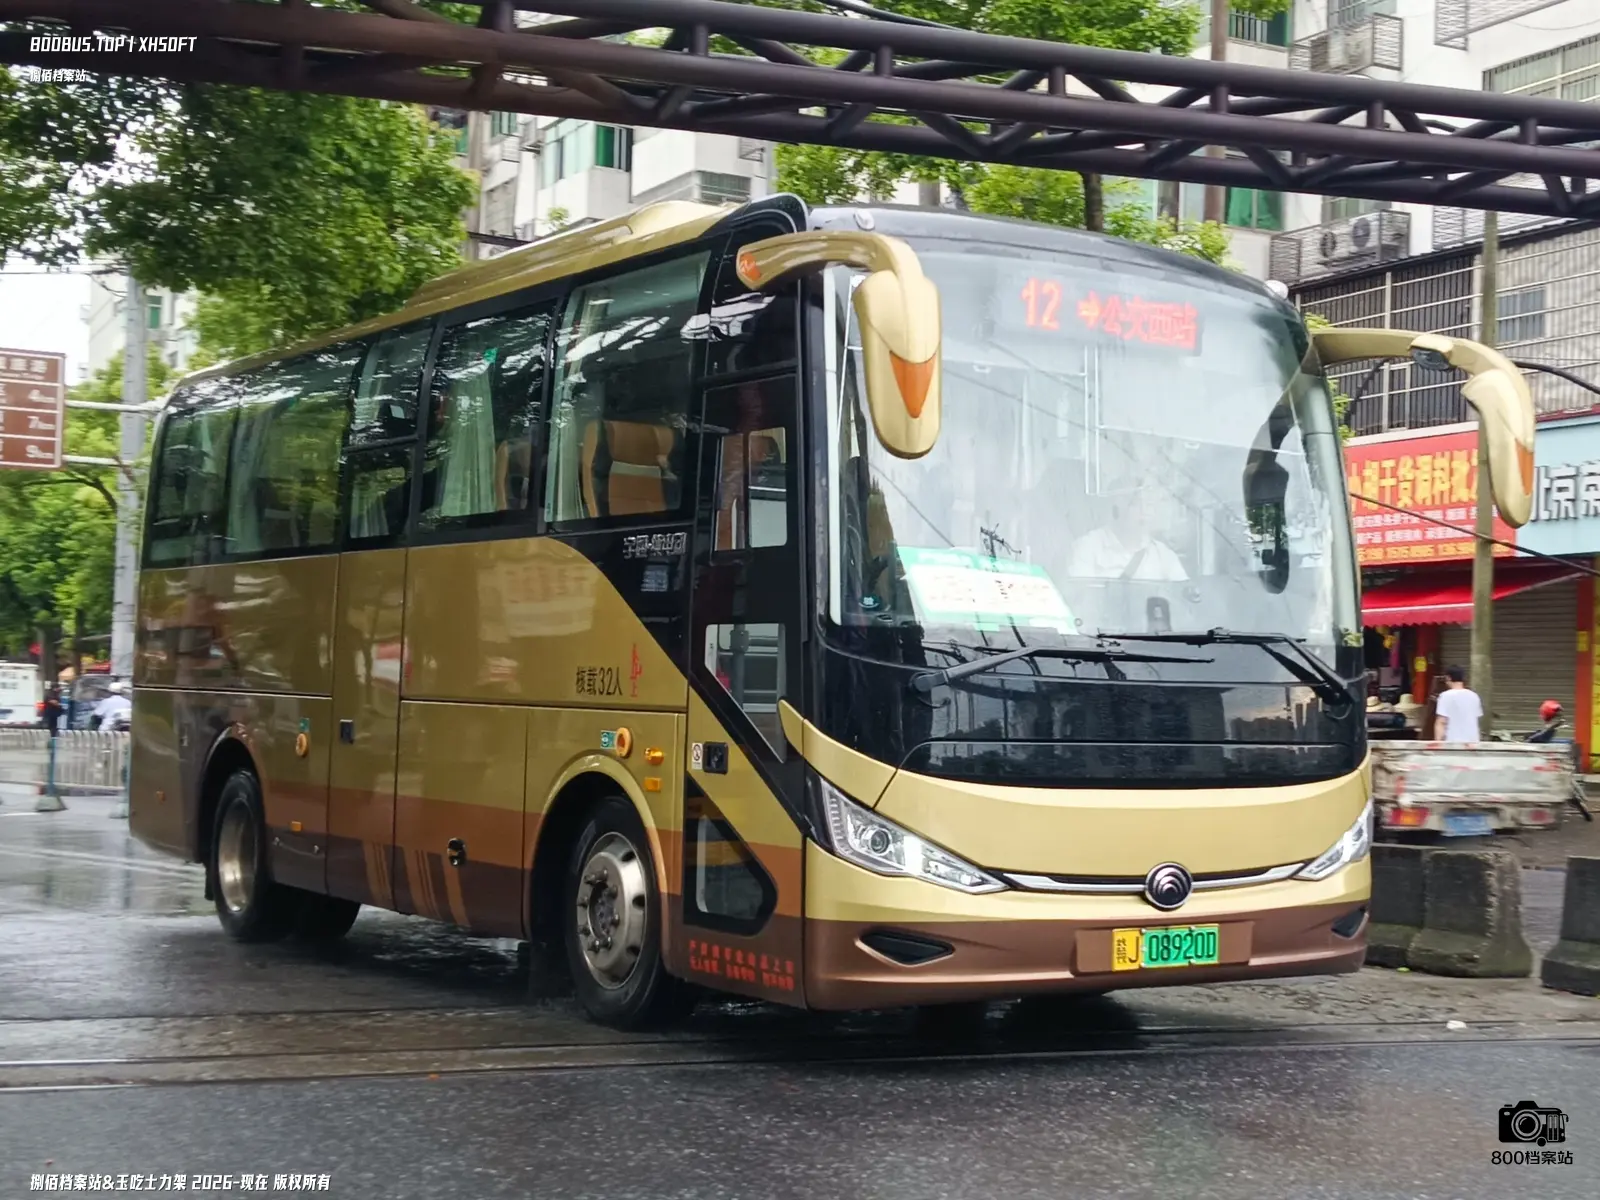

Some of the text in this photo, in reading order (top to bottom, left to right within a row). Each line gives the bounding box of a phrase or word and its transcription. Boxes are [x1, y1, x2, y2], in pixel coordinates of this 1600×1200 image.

[1020, 276, 1062, 331] 12
[576, 666, 623, 696] 核载32人
